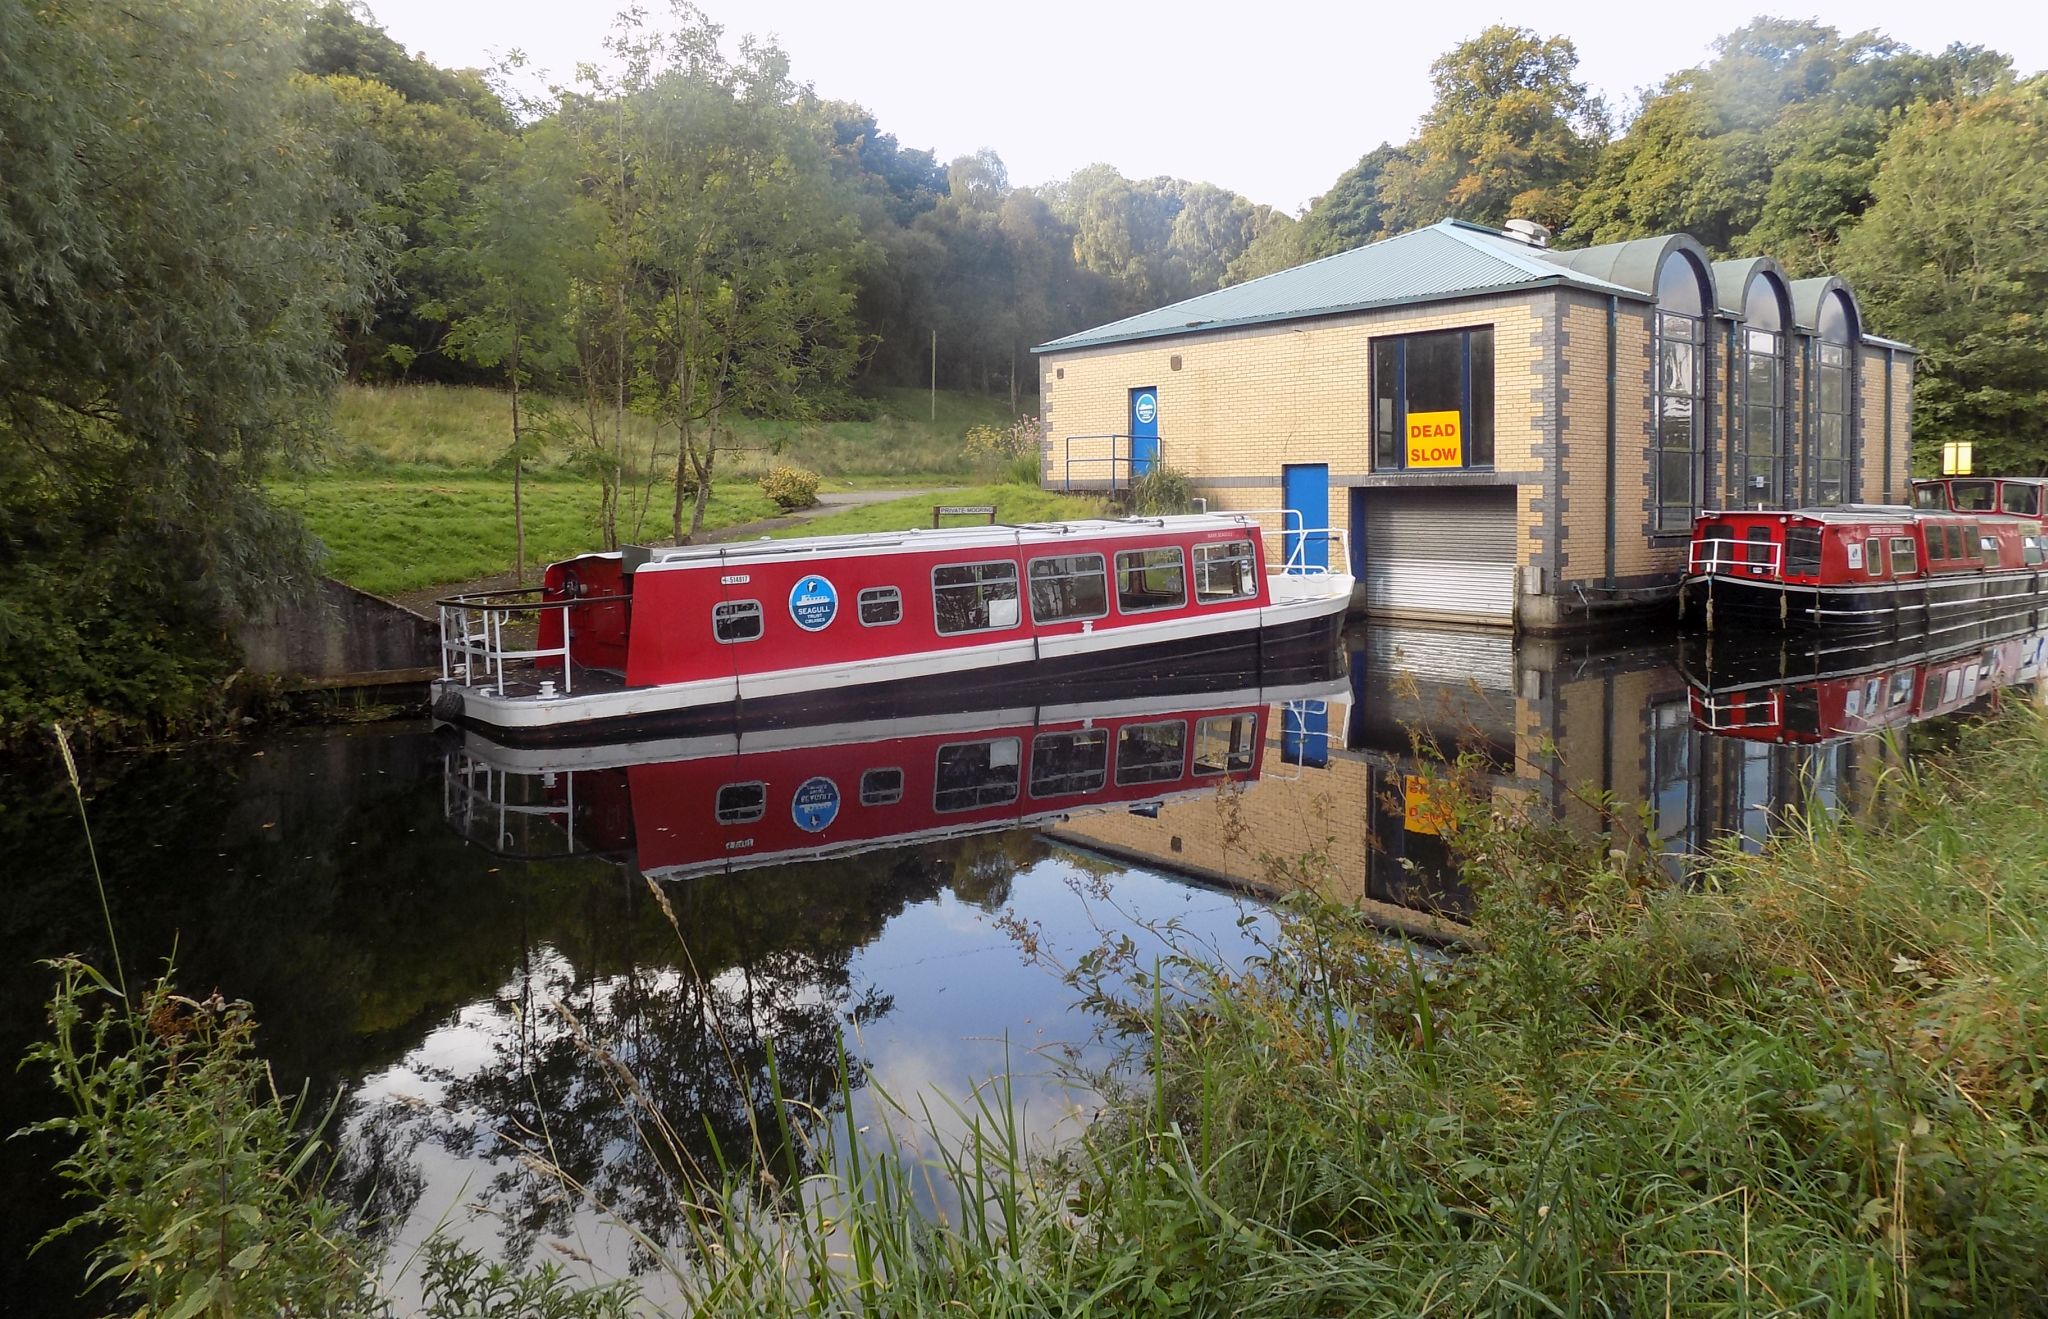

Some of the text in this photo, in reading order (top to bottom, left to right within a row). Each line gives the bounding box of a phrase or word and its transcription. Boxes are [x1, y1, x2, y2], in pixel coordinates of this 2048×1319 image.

[1411, 424, 1455, 438] DEAD
[1411, 448, 1457, 462] SLOW
[798, 606, 831, 615] SEAGULL
